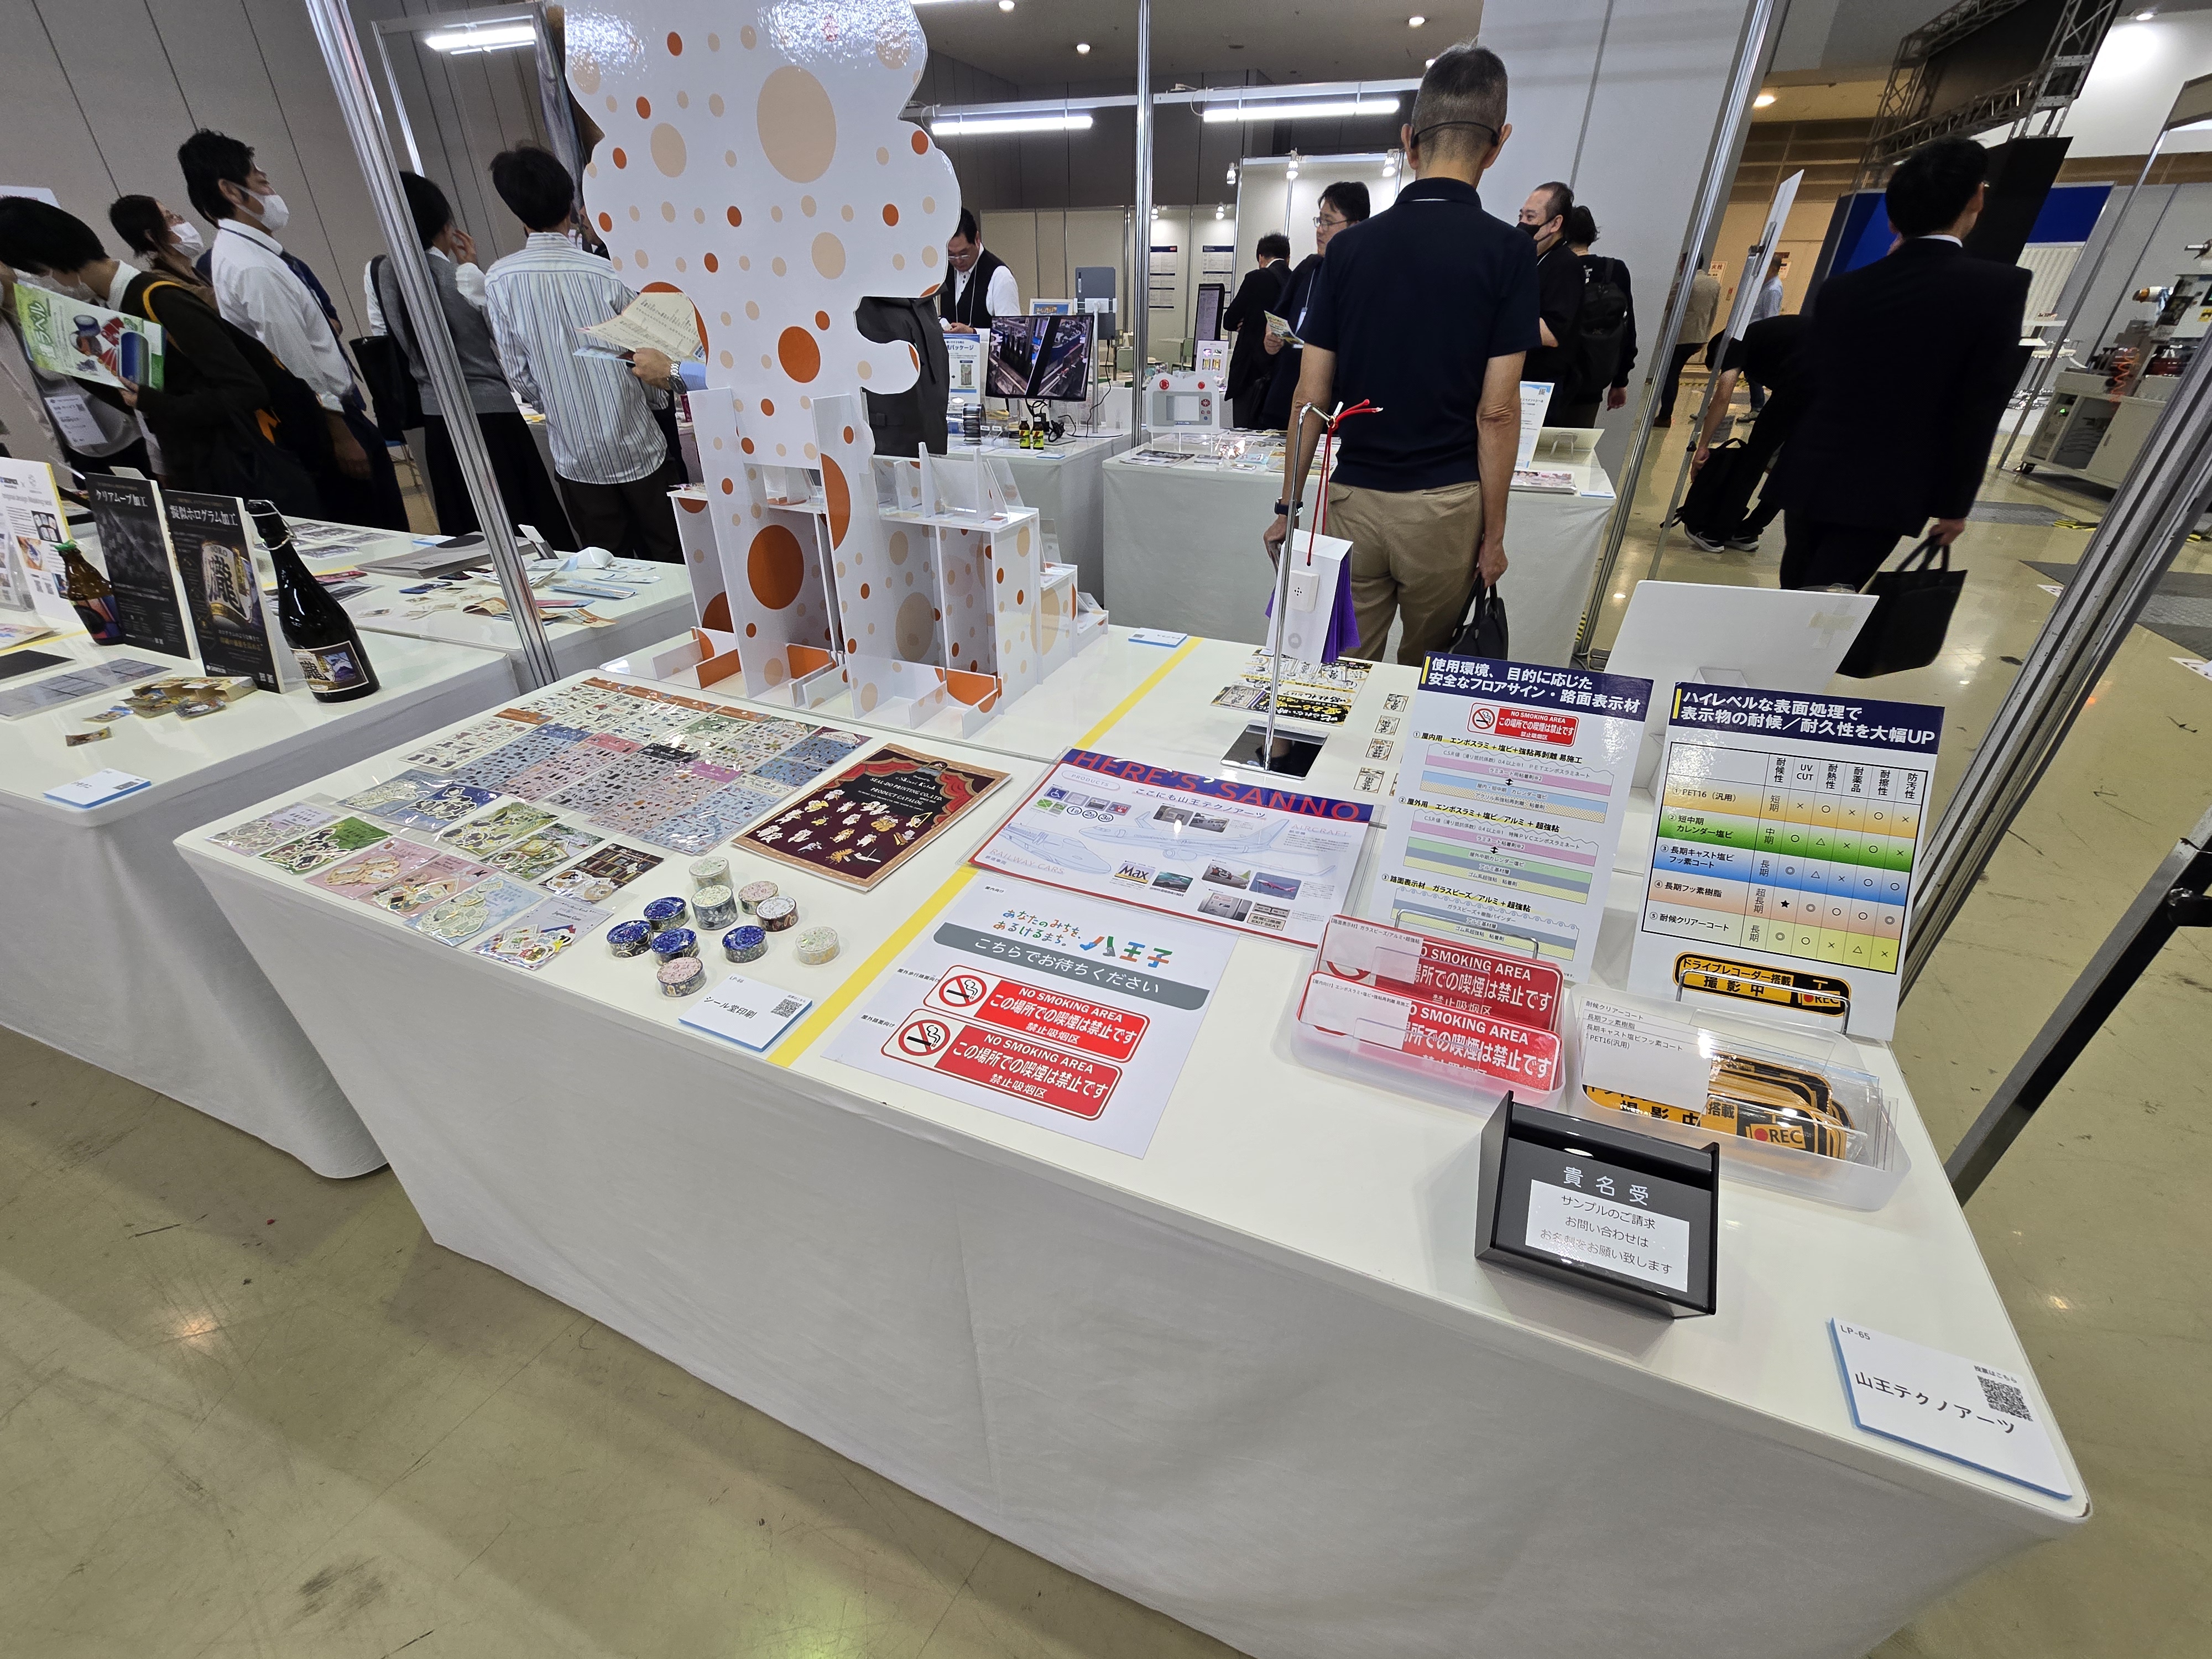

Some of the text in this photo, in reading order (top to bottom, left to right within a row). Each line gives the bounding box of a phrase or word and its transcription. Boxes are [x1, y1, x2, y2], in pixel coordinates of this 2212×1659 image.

[169, 504, 238, 526] 擬似ホログラム加工
[1428, 672, 1641, 714] 安全なフロアサイン・路面表示材
[1520, 712, 1548, 722] SMOKING
[1683, 691, 1863, 721] ハイレベルな表面処理で
[1499, 717, 1574, 737] この場所での喫煙は禁止です
[1421, 732, 1443, 742] 屋内用
[1559, 754, 1582, 764] 易施工
[1773, 758, 1786, 783] 耐候性
[1796, 773, 1814, 781] CUT
[1799, 764, 1813, 772] UV
[1825, 763, 1838, 790] 耐熱性
[1851, 766, 1864, 792] 耐薬品
[870, 777, 893, 787] SEAL-DO
[894, 784, 919, 795] PRINTING
[1071, 774, 1109, 787] PRODUCTS
[1905, 773, 1918, 799] 防汚性
[870, 787, 924, 805] PRODUCT CATALOG
[1135, 789, 1265, 818] ここにも山王テクノアーツ
[1216, 782, 1359, 821] SANNO
[1407, 797, 1428, 808] 屋外用
[1292, 823, 1349, 837] AIRCRAFT
[1676, 824, 1734, 839] カレンダー塩ビ
[1678, 815, 1705, 826] 短中期
[990, 848, 1064, 874] RAILWAY CARS
[1669, 854, 1715, 869] フッ素コート
[1671, 845, 1735, 862] 長期キャスト塩ビ
[1118, 865, 1150, 880] Max
[1390, 875, 1426, 889] 路面表示材
[984, 885, 1005, 894] 屋内向け
[1665, 881, 1723, 898] 長期フッ素樹脂
[1003, 908, 1082, 940] あなたのみちを、
[1660, 913, 1729, 931] 耐候クリアーコート
[993, 921, 1067, 948] あるけるまち。
[1079, 936, 1173, 968] 八王子
[974, 936, 1160, 994] こちらでお待ちください
[1430, 950, 1491, 971] SMOKING
[1495, 963, 1531, 981] AREA
[1414, 964, 1552, 1012] 所での喫煙は禁止です
[1814, 991, 1839, 1005] REC
[703, 996, 758, 1019] シール堂印刷
[1019, 987, 1123, 1022] NO SMOKING AREA
[1585, 1000, 1644, 1021] 耐候クリアーコート
[989, 994, 1138, 1045] この場所での喫煙は禁止です
[1420, 1010, 1485, 1033] SMOKING
[1489, 1026, 1529, 1045] AREA
[1587, 1013, 1635, 1030] 長期フッ素樹脂
[1025, 1022, 1082, 1044] 禁止吸烟区
[1586, 1022, 1683, 1052] 長期キャスト塩ビフッ素コート
[984, 1034, 1094, 1074] NO SMOKING AREA
[1404, 1022, 1552, 1079] 所での喫煙は禁止です
[952, 1041, 1109, 1098] この場所での喫煙は禁止です
[989, 1074, 1048, 1098] 禁止吸烟区
[1769, 1129, 1804, 1144] REC
[1563, 1166, 1649, 1206] 貴名受
[1561, 1194, 1656, 1230] サンプルのご請求
[1564, 1217, 1649, 1248] お問い合わせは
[1540, 1228, 1673, 1275] お名刺をお願い致します
[1840, 1324, 1871, 1340] LP-65
[1974, 1365, 2017, 1384] 投票はこちら
[1854, 1371, 2015, 1434] 山王テクノアーツ
